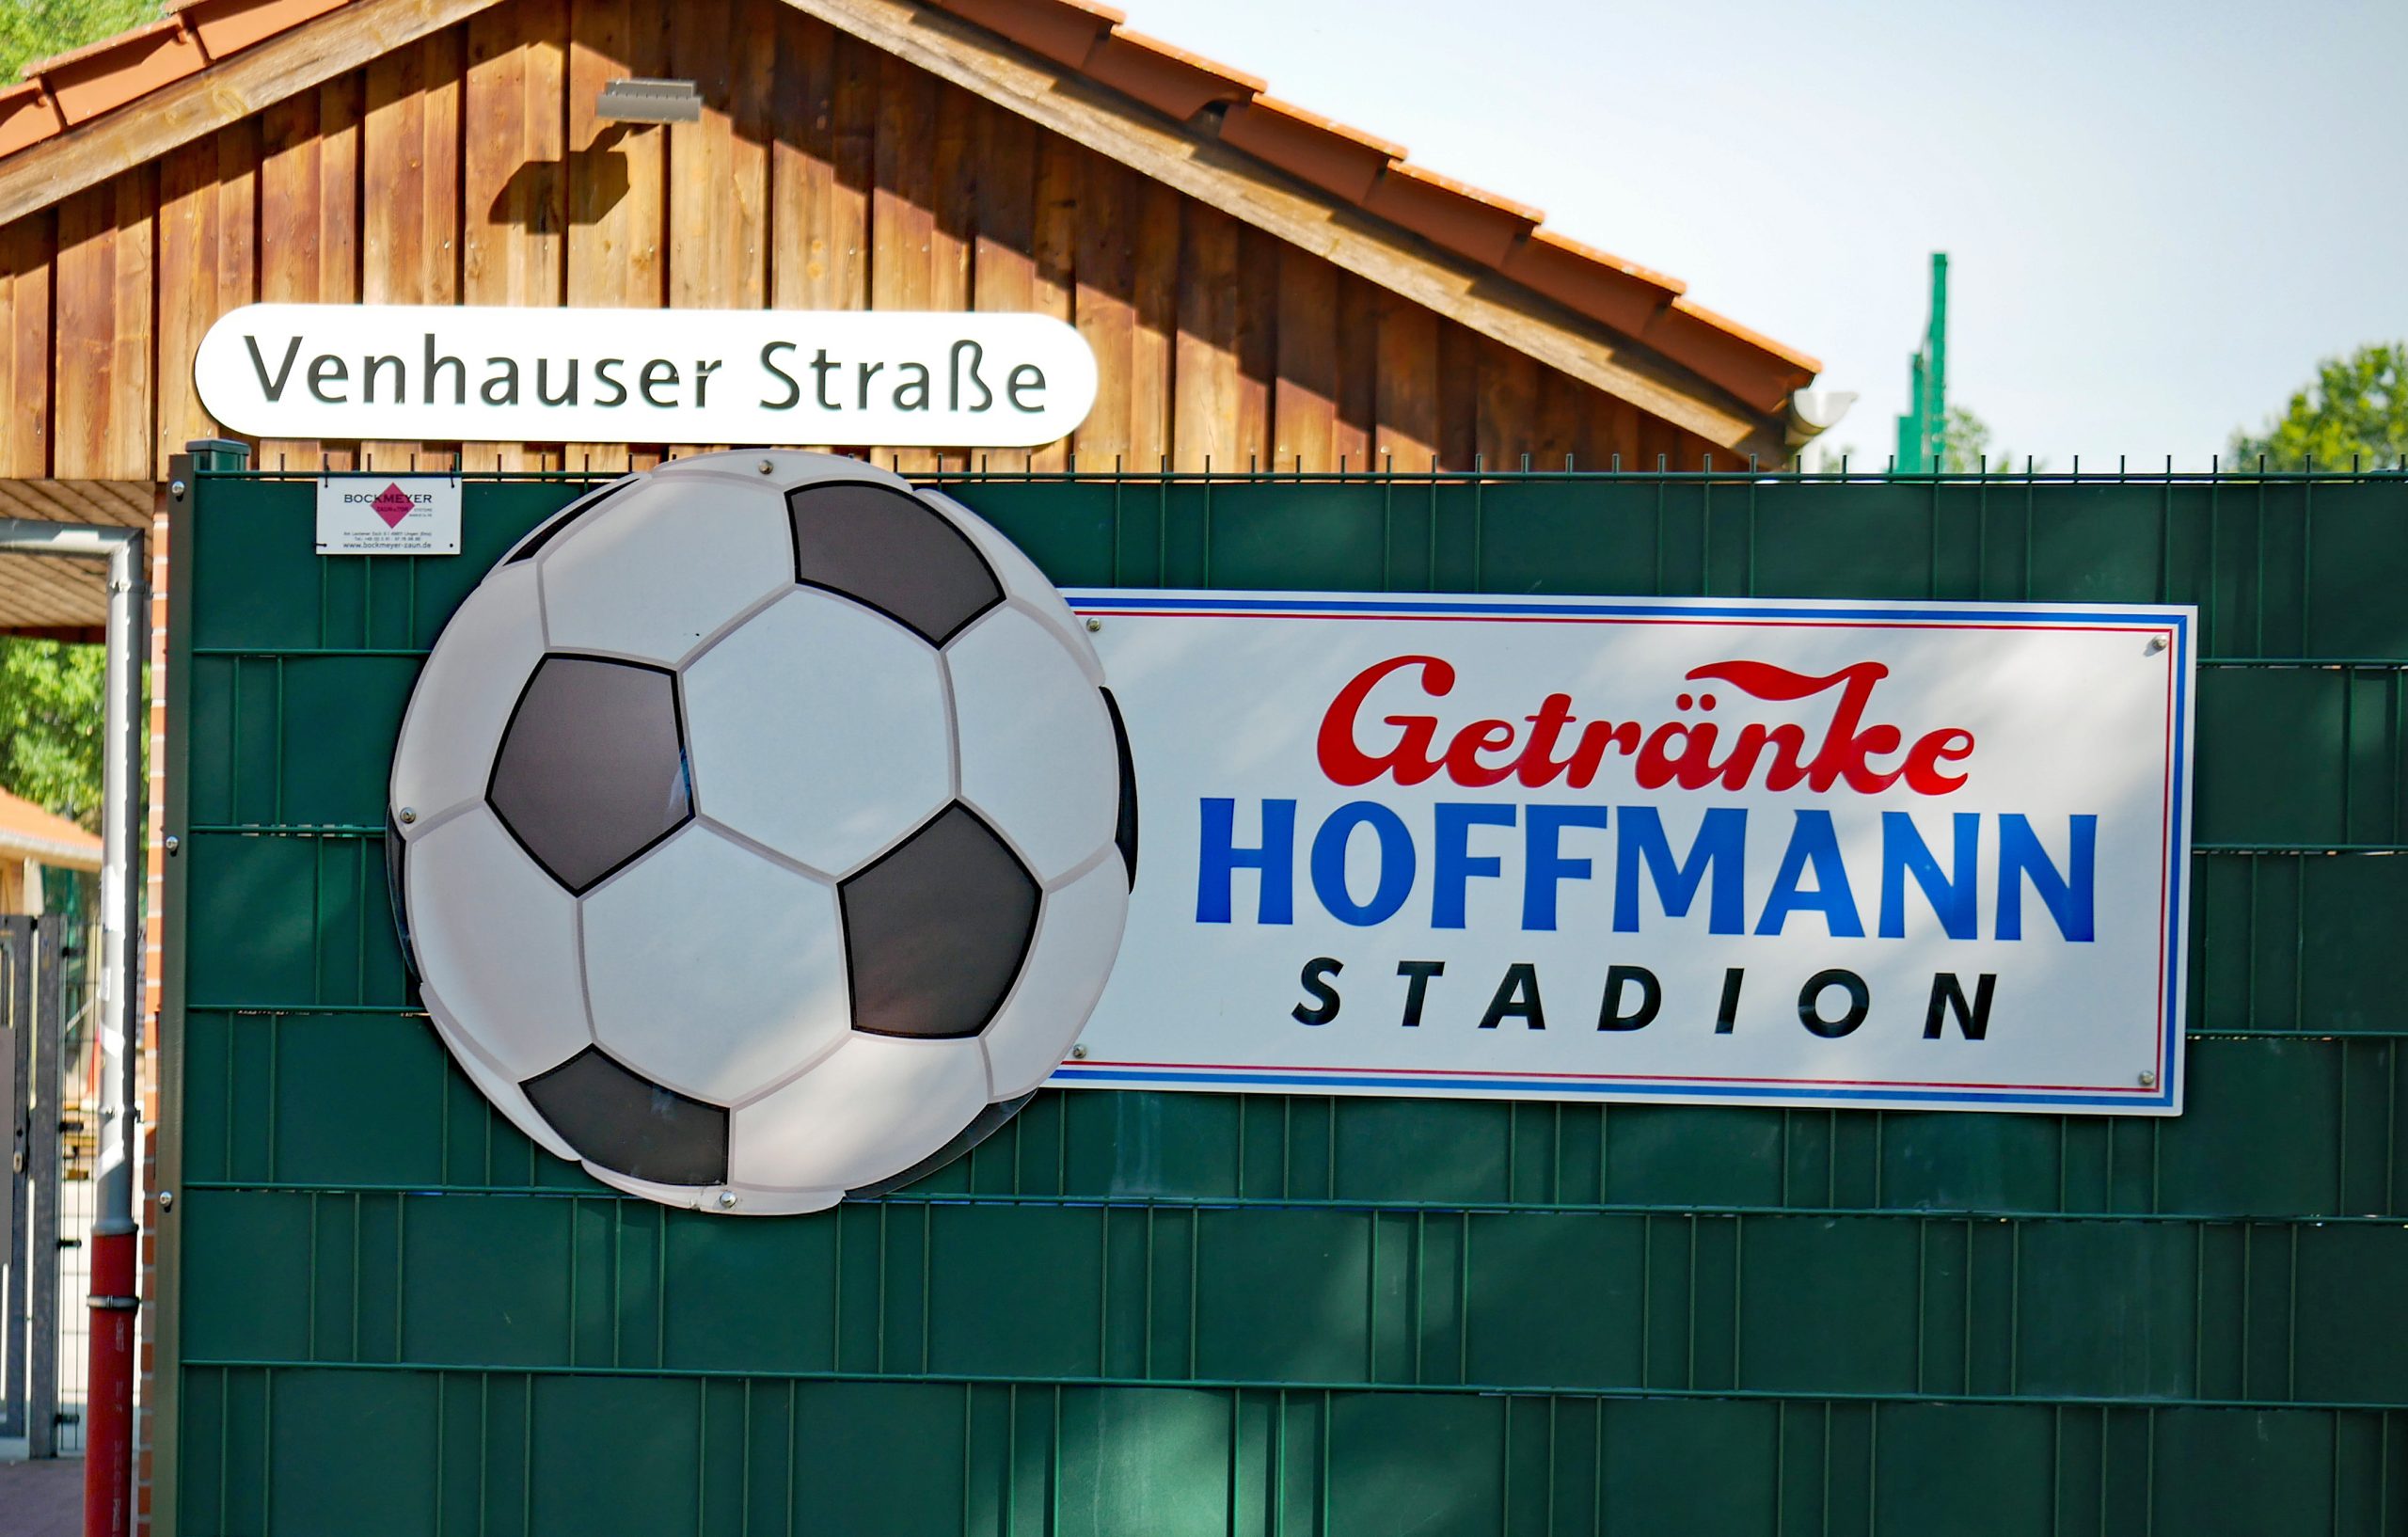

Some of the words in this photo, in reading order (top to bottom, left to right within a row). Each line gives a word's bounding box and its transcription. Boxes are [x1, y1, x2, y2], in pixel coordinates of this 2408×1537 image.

[245, 334, 721, 407] Venhauser
[759, 341, 1046, 413] Straße
[343, 494, 433, 503] BOCKMEYER
[1317, 655, 1975, 796] Getränke
[1195, 798, 2098, 943] HOFFMANN
[1291, 957, 1998, 1040] STADION
